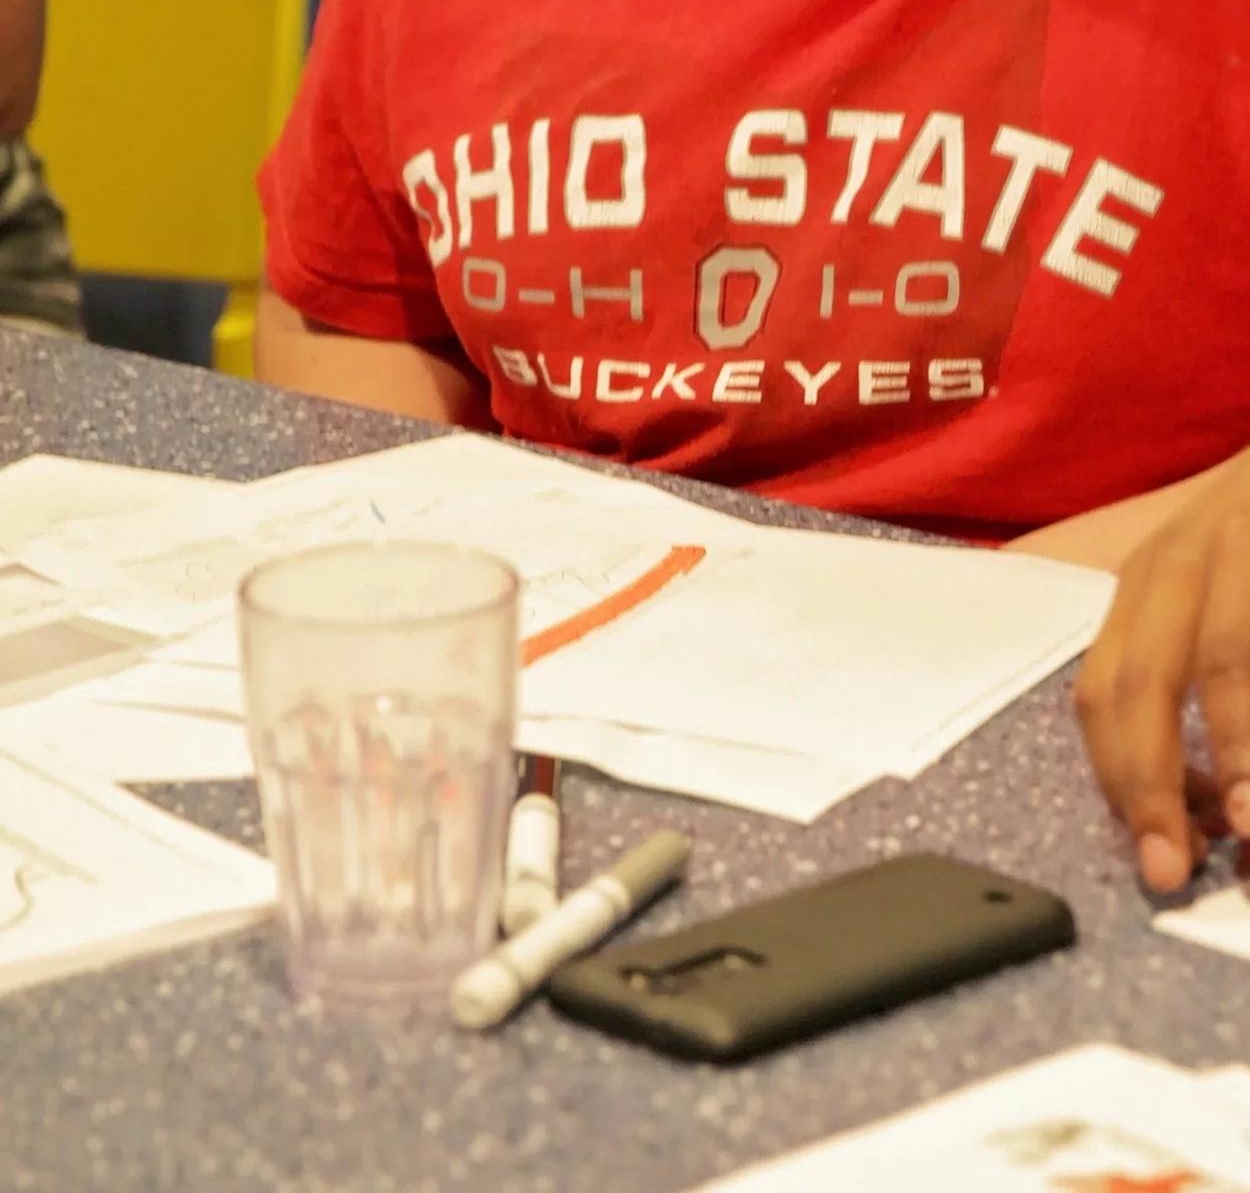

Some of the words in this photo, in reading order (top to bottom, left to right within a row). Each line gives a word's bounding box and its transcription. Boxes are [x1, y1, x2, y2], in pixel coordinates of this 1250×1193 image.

[402, 114, 646, 268] OHIO
[724, 109, 1165, 298] STATE
[462, 257, 644, 322] O-H
[819, 259, 961, 318] I-O
